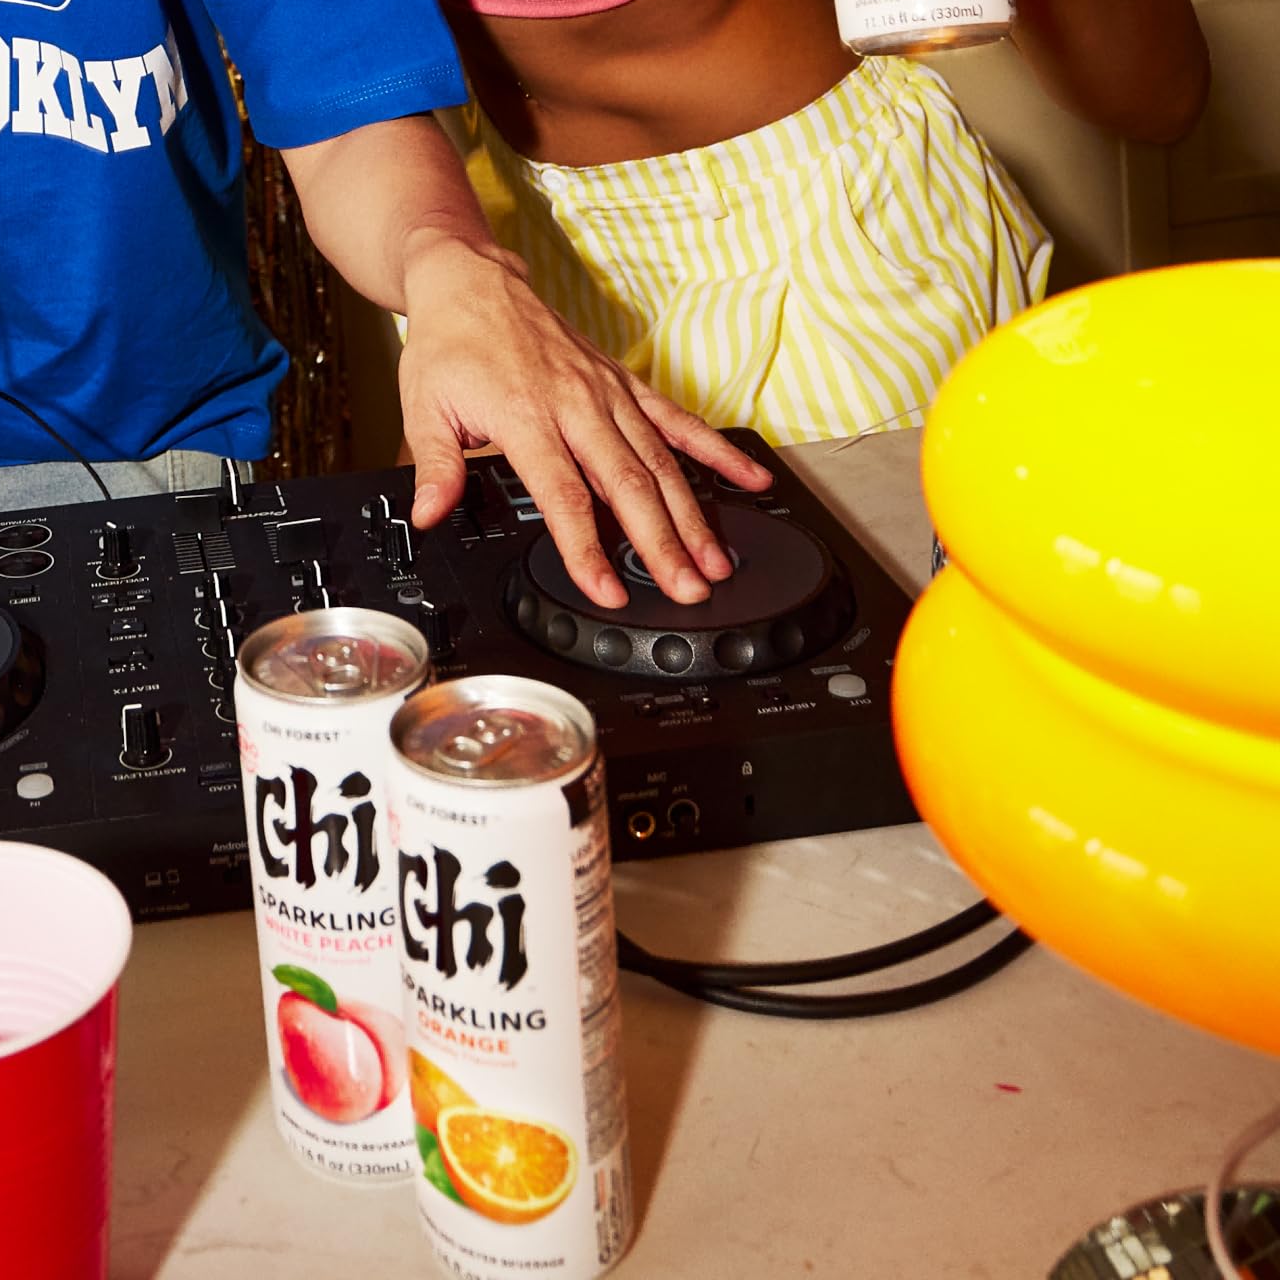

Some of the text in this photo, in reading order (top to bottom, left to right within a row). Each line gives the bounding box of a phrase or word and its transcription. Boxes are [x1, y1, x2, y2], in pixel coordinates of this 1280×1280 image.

[931, 4, 984, 22] (330mL)
[112, 683, 160, 695] BEAT FX
[285, 728, 340, 743] FOREST
[259, 884, 396, 931] SPARKLING
[319, 933, 394, 952] PEACH
[418, 1010, 510, 1055] ORANGE
